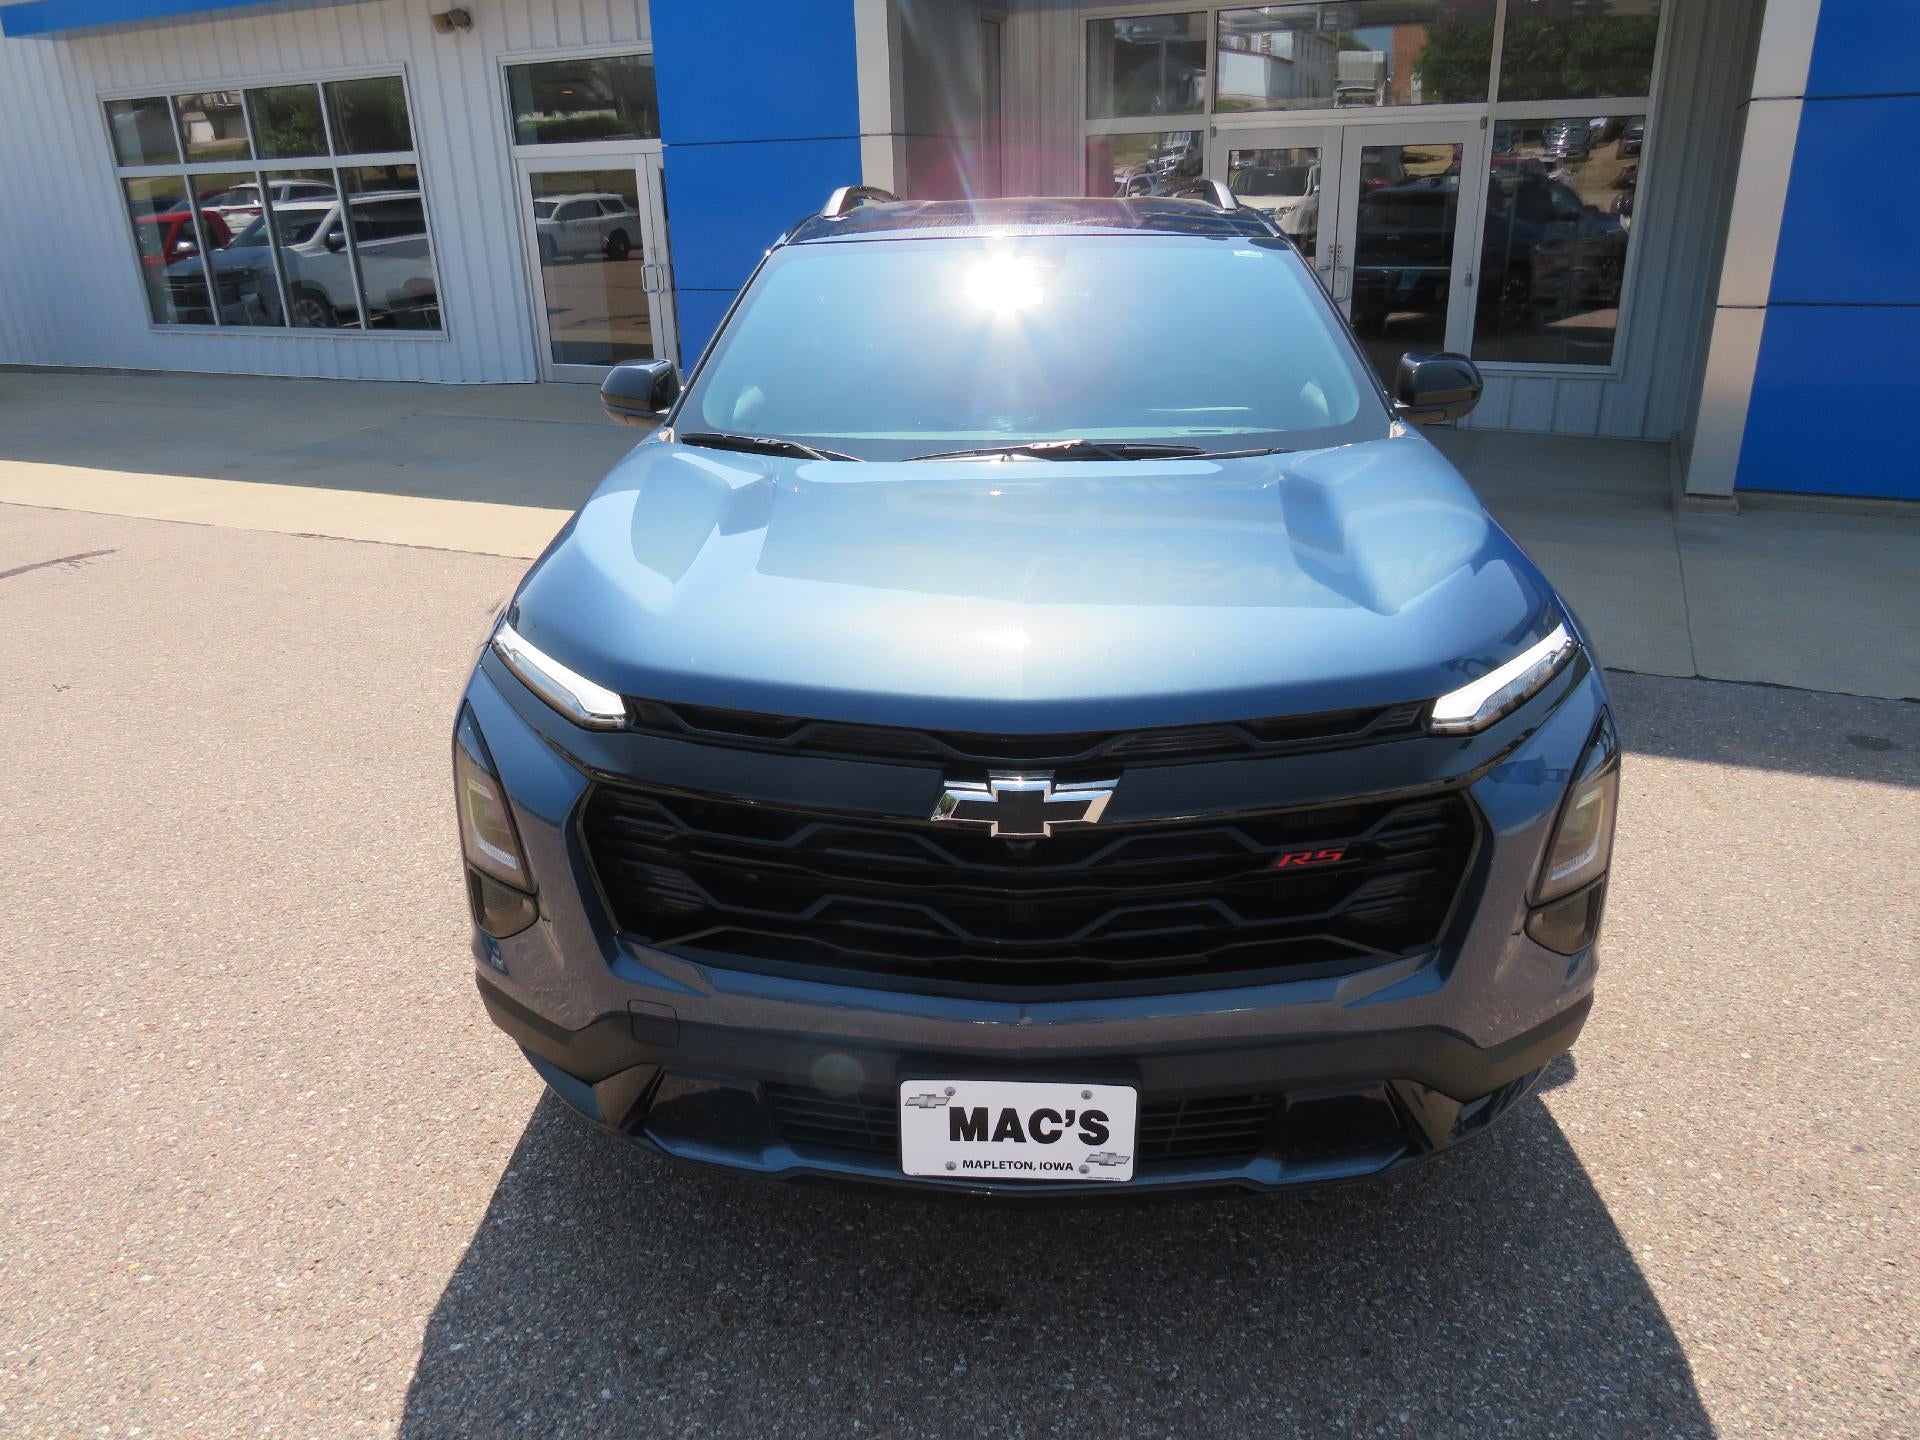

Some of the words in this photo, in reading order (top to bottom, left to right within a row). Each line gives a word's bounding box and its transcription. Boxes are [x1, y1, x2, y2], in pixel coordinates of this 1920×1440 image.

[1275, 847, 1346, 868] RS
[949, 1106, 1110, 1146] MAC'S
[962, 1159, 1037, 1171] MAPLETON,
[1039, 1161, 1074, 1171] IOWA
